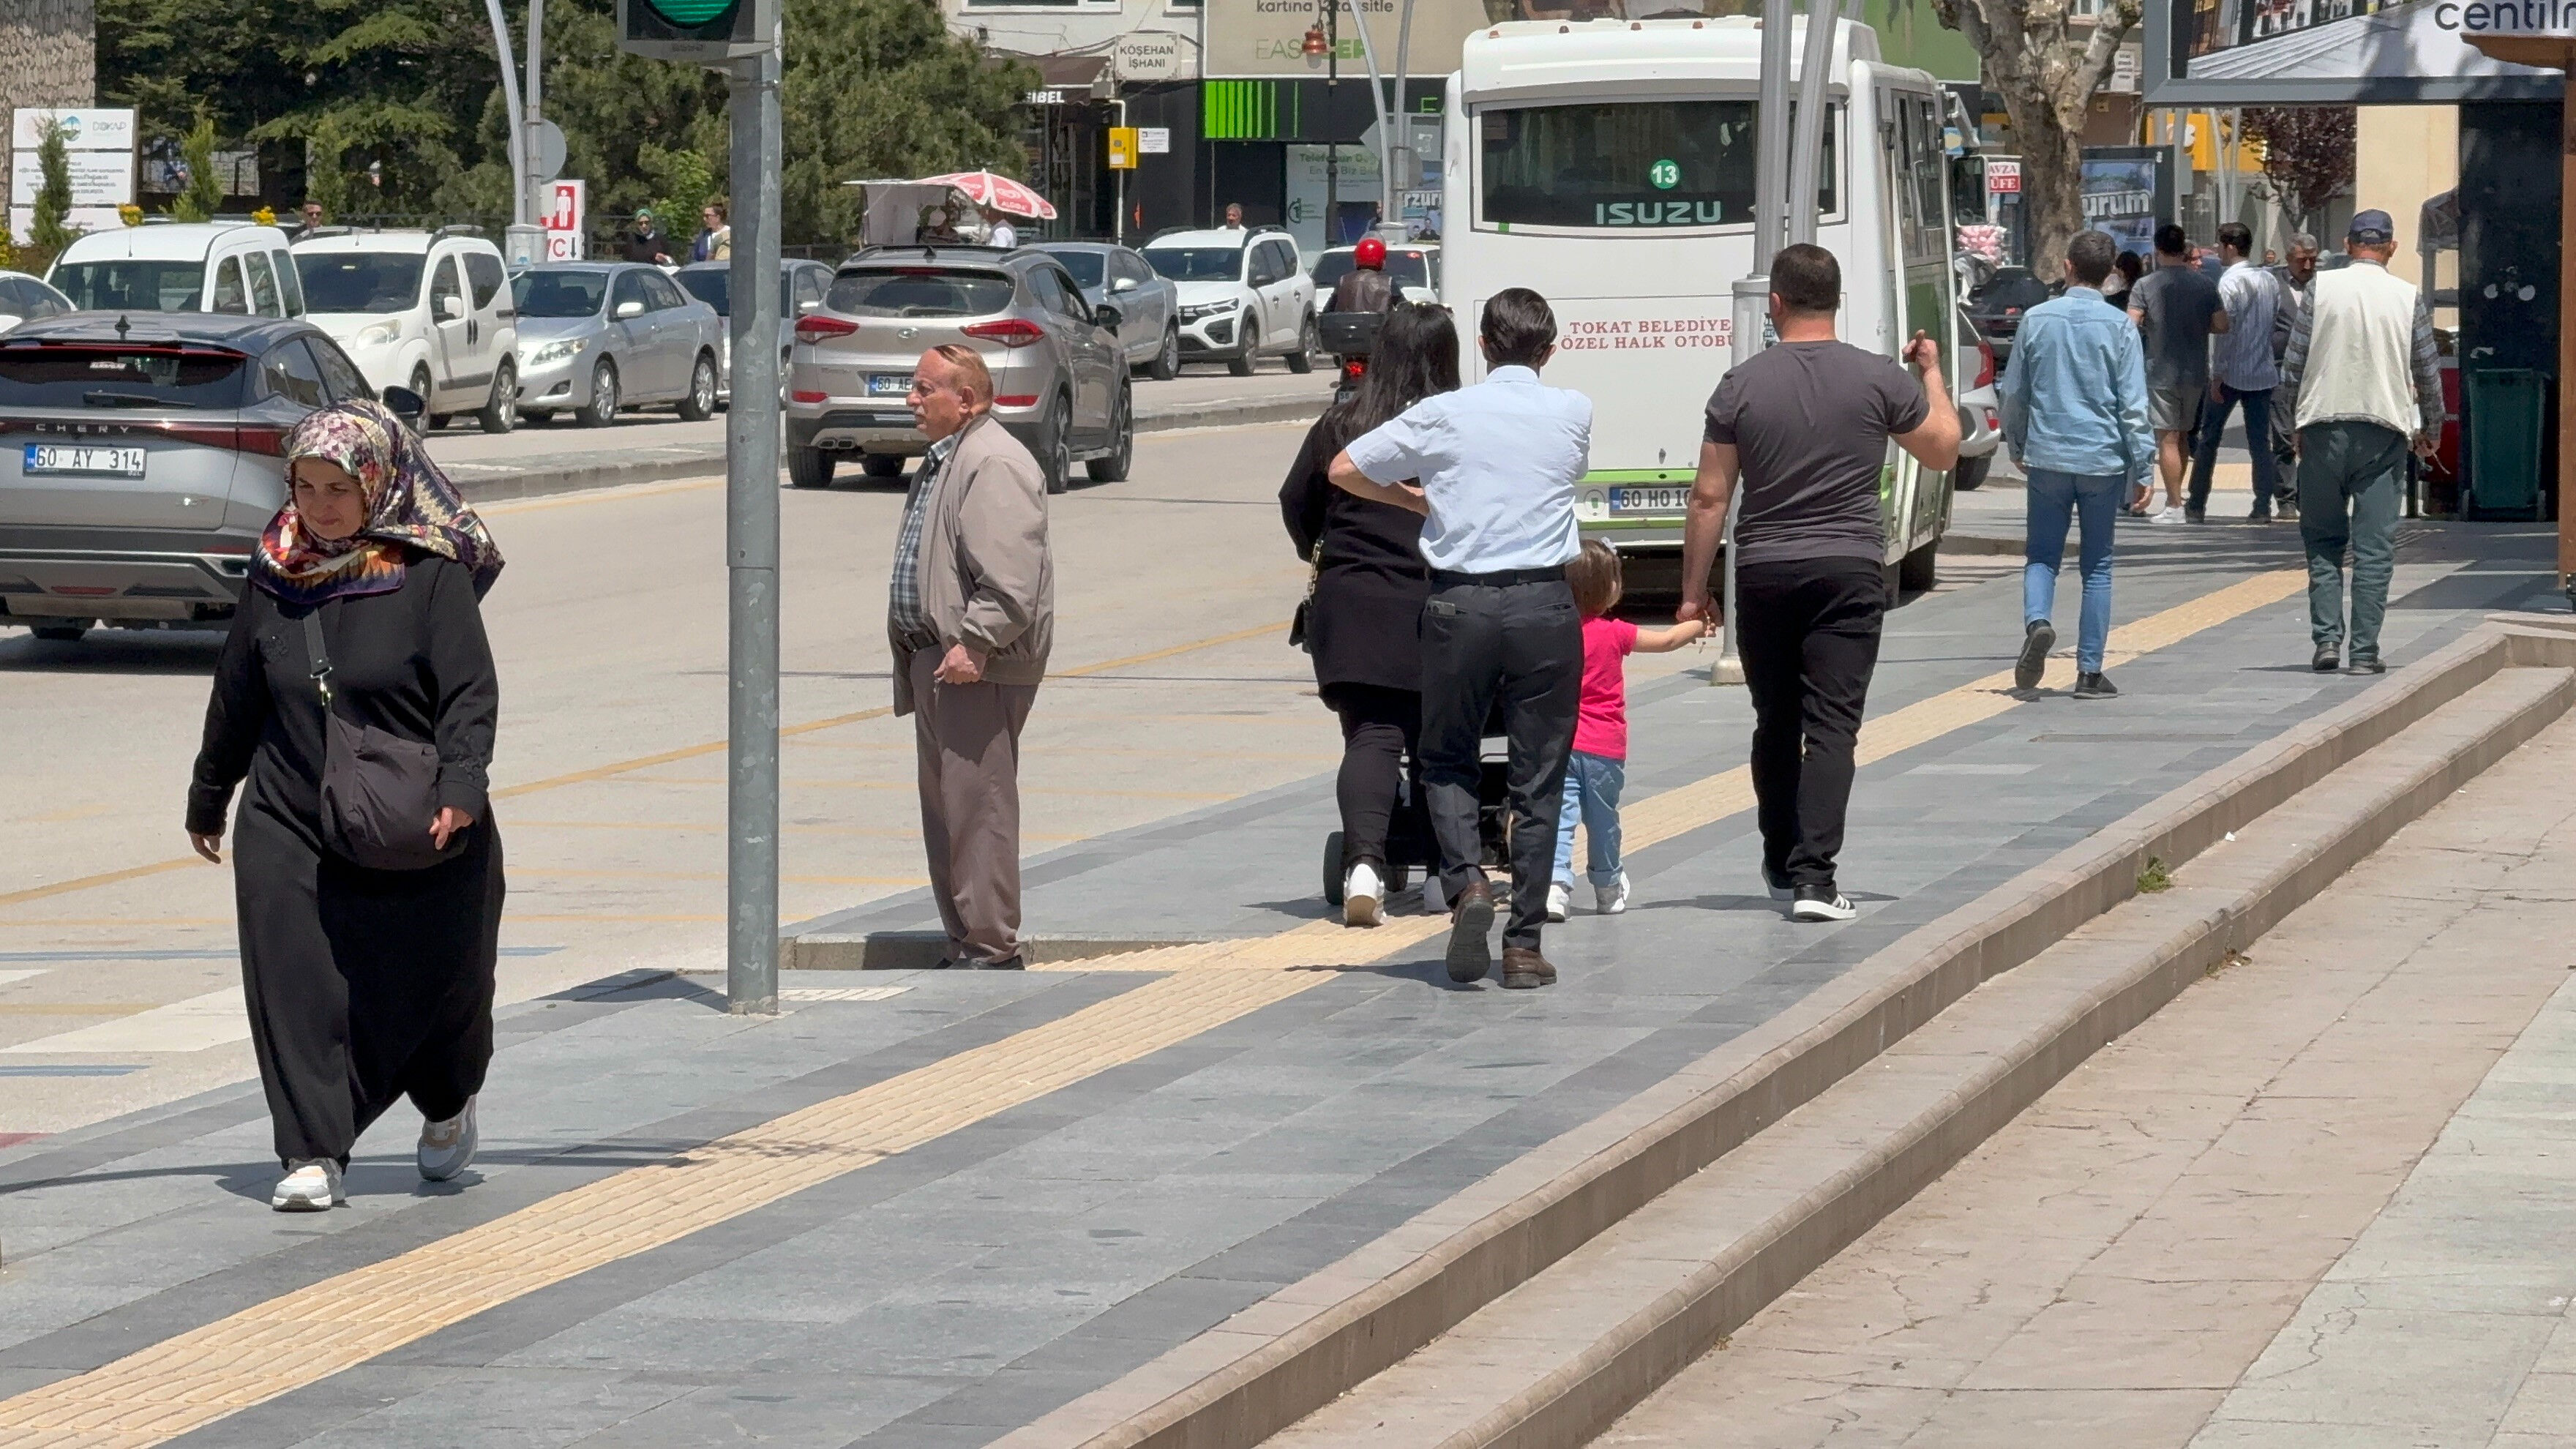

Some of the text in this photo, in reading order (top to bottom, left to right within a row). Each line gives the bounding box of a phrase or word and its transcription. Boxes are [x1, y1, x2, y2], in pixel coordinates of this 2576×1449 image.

[1334, 0, 1393, 12] tasitle
[1120, 44, 1174, 57] KÖŞEHAN
[1128, 58, 1165, 70] İŞHANI
[1652, 165, 1677, 184] 13
[1404, 192, 1442, 208] rzur
[2081, 192, 2149, 217] urum
[1595, 201, 1722, 225] ISUZU
[547, 238, 566, 258] C
[1569, 315, 1731, 334] TOKAT BELEDİYE
[1560, 331, 1733, 351] ÖZEL HALK OTOB
[36, 422, 130, 434] CHERY
[36, 448, 56, 467] 60
[72, 450, 93, 470] AY
[109, 450, 141, 470] 314
[1621, 490, 1641, 507] 60
